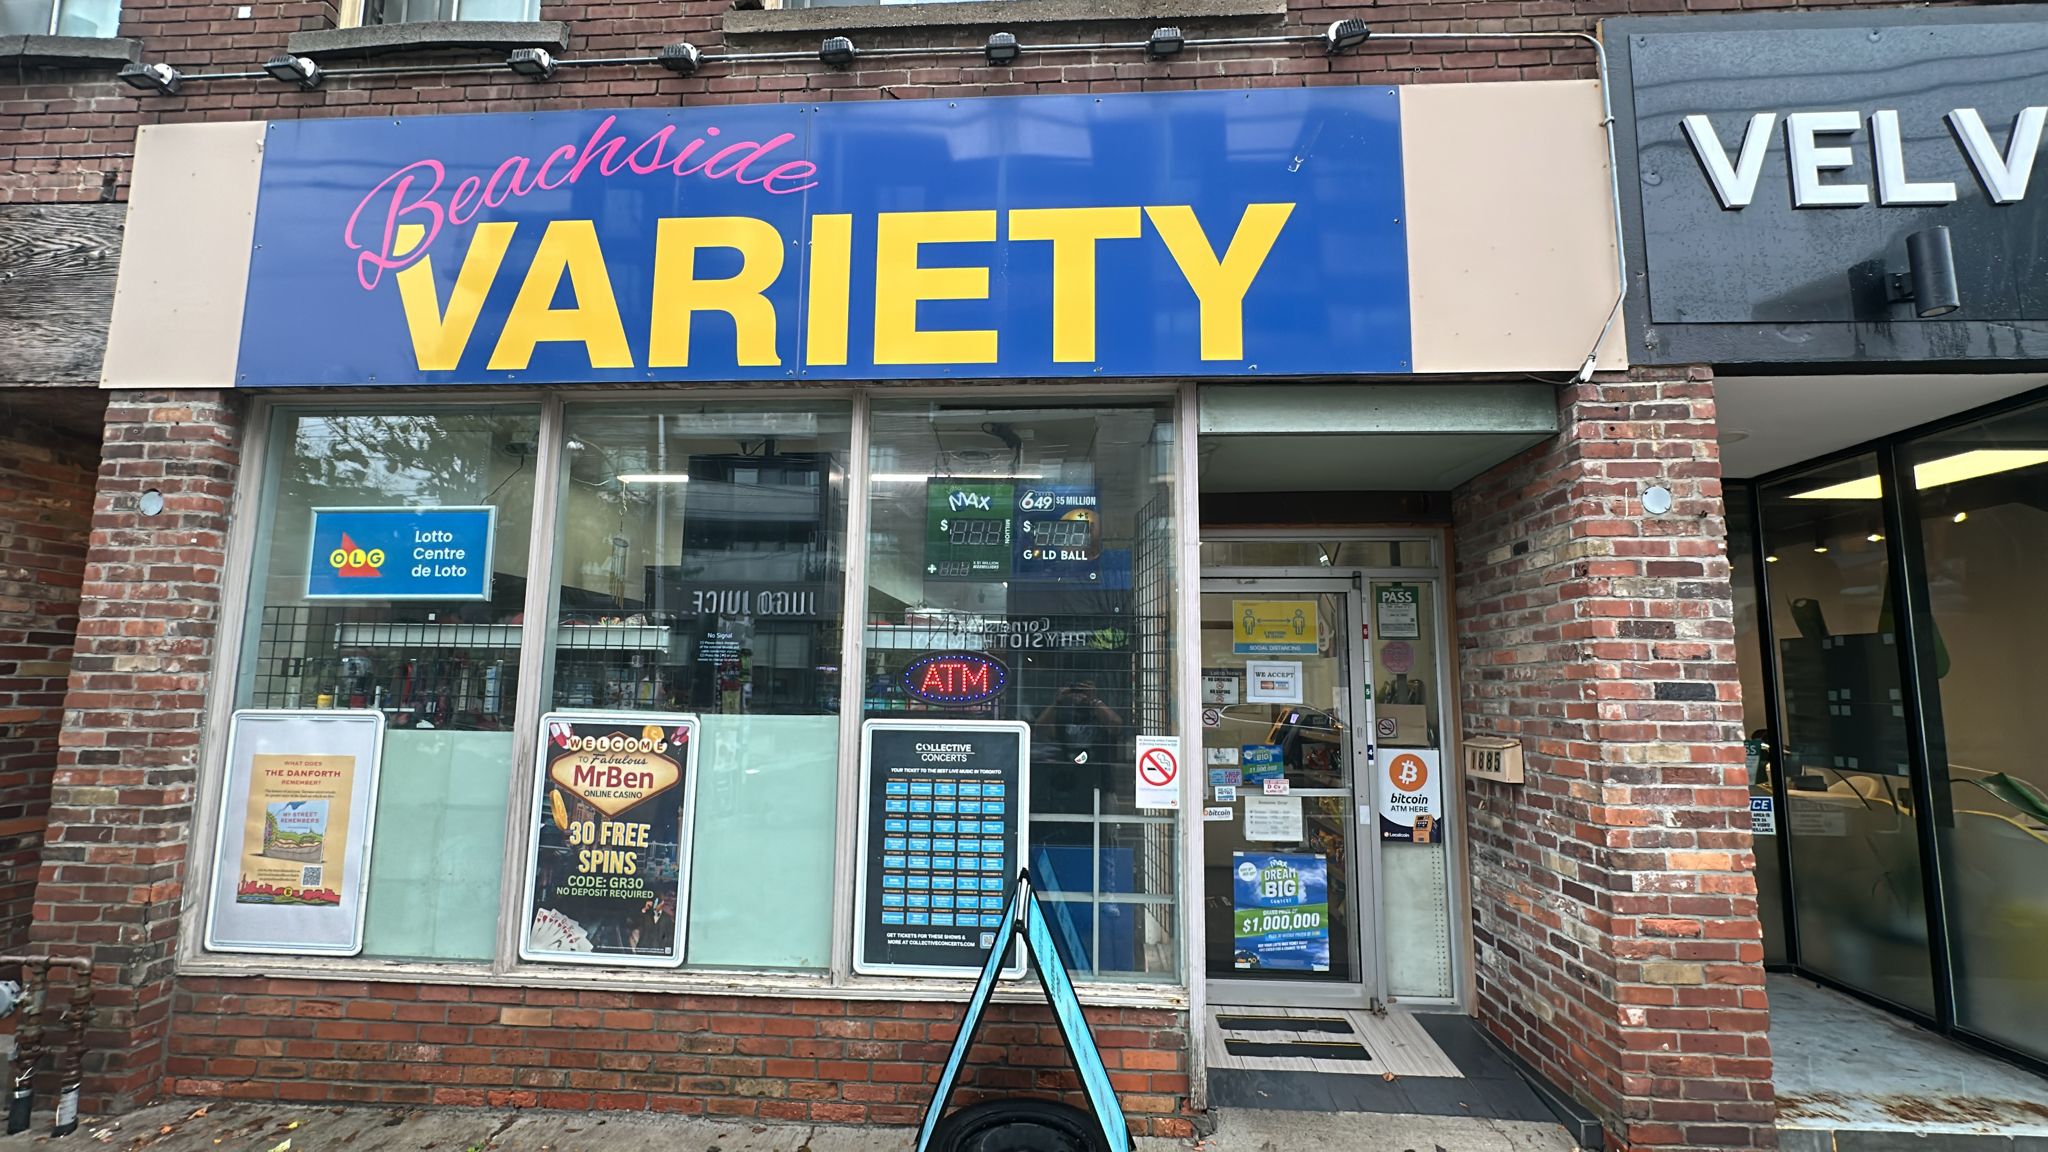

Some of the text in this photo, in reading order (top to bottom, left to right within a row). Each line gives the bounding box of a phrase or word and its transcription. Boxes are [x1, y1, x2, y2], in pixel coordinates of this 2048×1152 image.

[1682, 106, 2048, 210] VELV
[344, 115, 819, 290] Beachside
[396, 203, 1296, 372] VARIETY
[948, 491, 991, 512] MAX
[1056, 496, 1096, 506] $5 MILLION
[415, 530, 453, 543] Lotto
[332, 551, 383, 566] OLG
[413, 547, 466, 560] Centre
[1061, 550, 1088, 560] BALL
[411, 564, 467, 577] de Loto
[1382, 591, 1413, 603] PASS
[716, 632, 733, 640] Signal
[921, 664, 988, 693] ATM
[1267, 671, 1294, 679] ACCEPT
[569, 738, 664, 751] WELCOME
[915, 743, 972, 752] COLLECTIVE
[578, 753, 648, 765] TO Fabulous
[921, 753, 968, 762] CONCERTS
[1471, 751, 1501, 771] 1885
[265, 769, 284, 777] THE
[573, 764, 654, 789] MrBen
[583, 789, 643, 799] ONLINE CASINO
[1391, 793, 1429, 804] bitcoin
[1409, 805, 1429, 813] HERE
[569, 821, 651, 848] 30 FREE
[578, 849, 637, 875] SPINS
[1264, 867, 1296, 880] DREAM
[567, 875, 644, 889] CODE: GR30
[556, 887, 654, 899] NO DEPOSIT REQUIRED
[1265, 880, 1297, 898] BIG
[1242, 912, 1320, 933] $1,000,000
